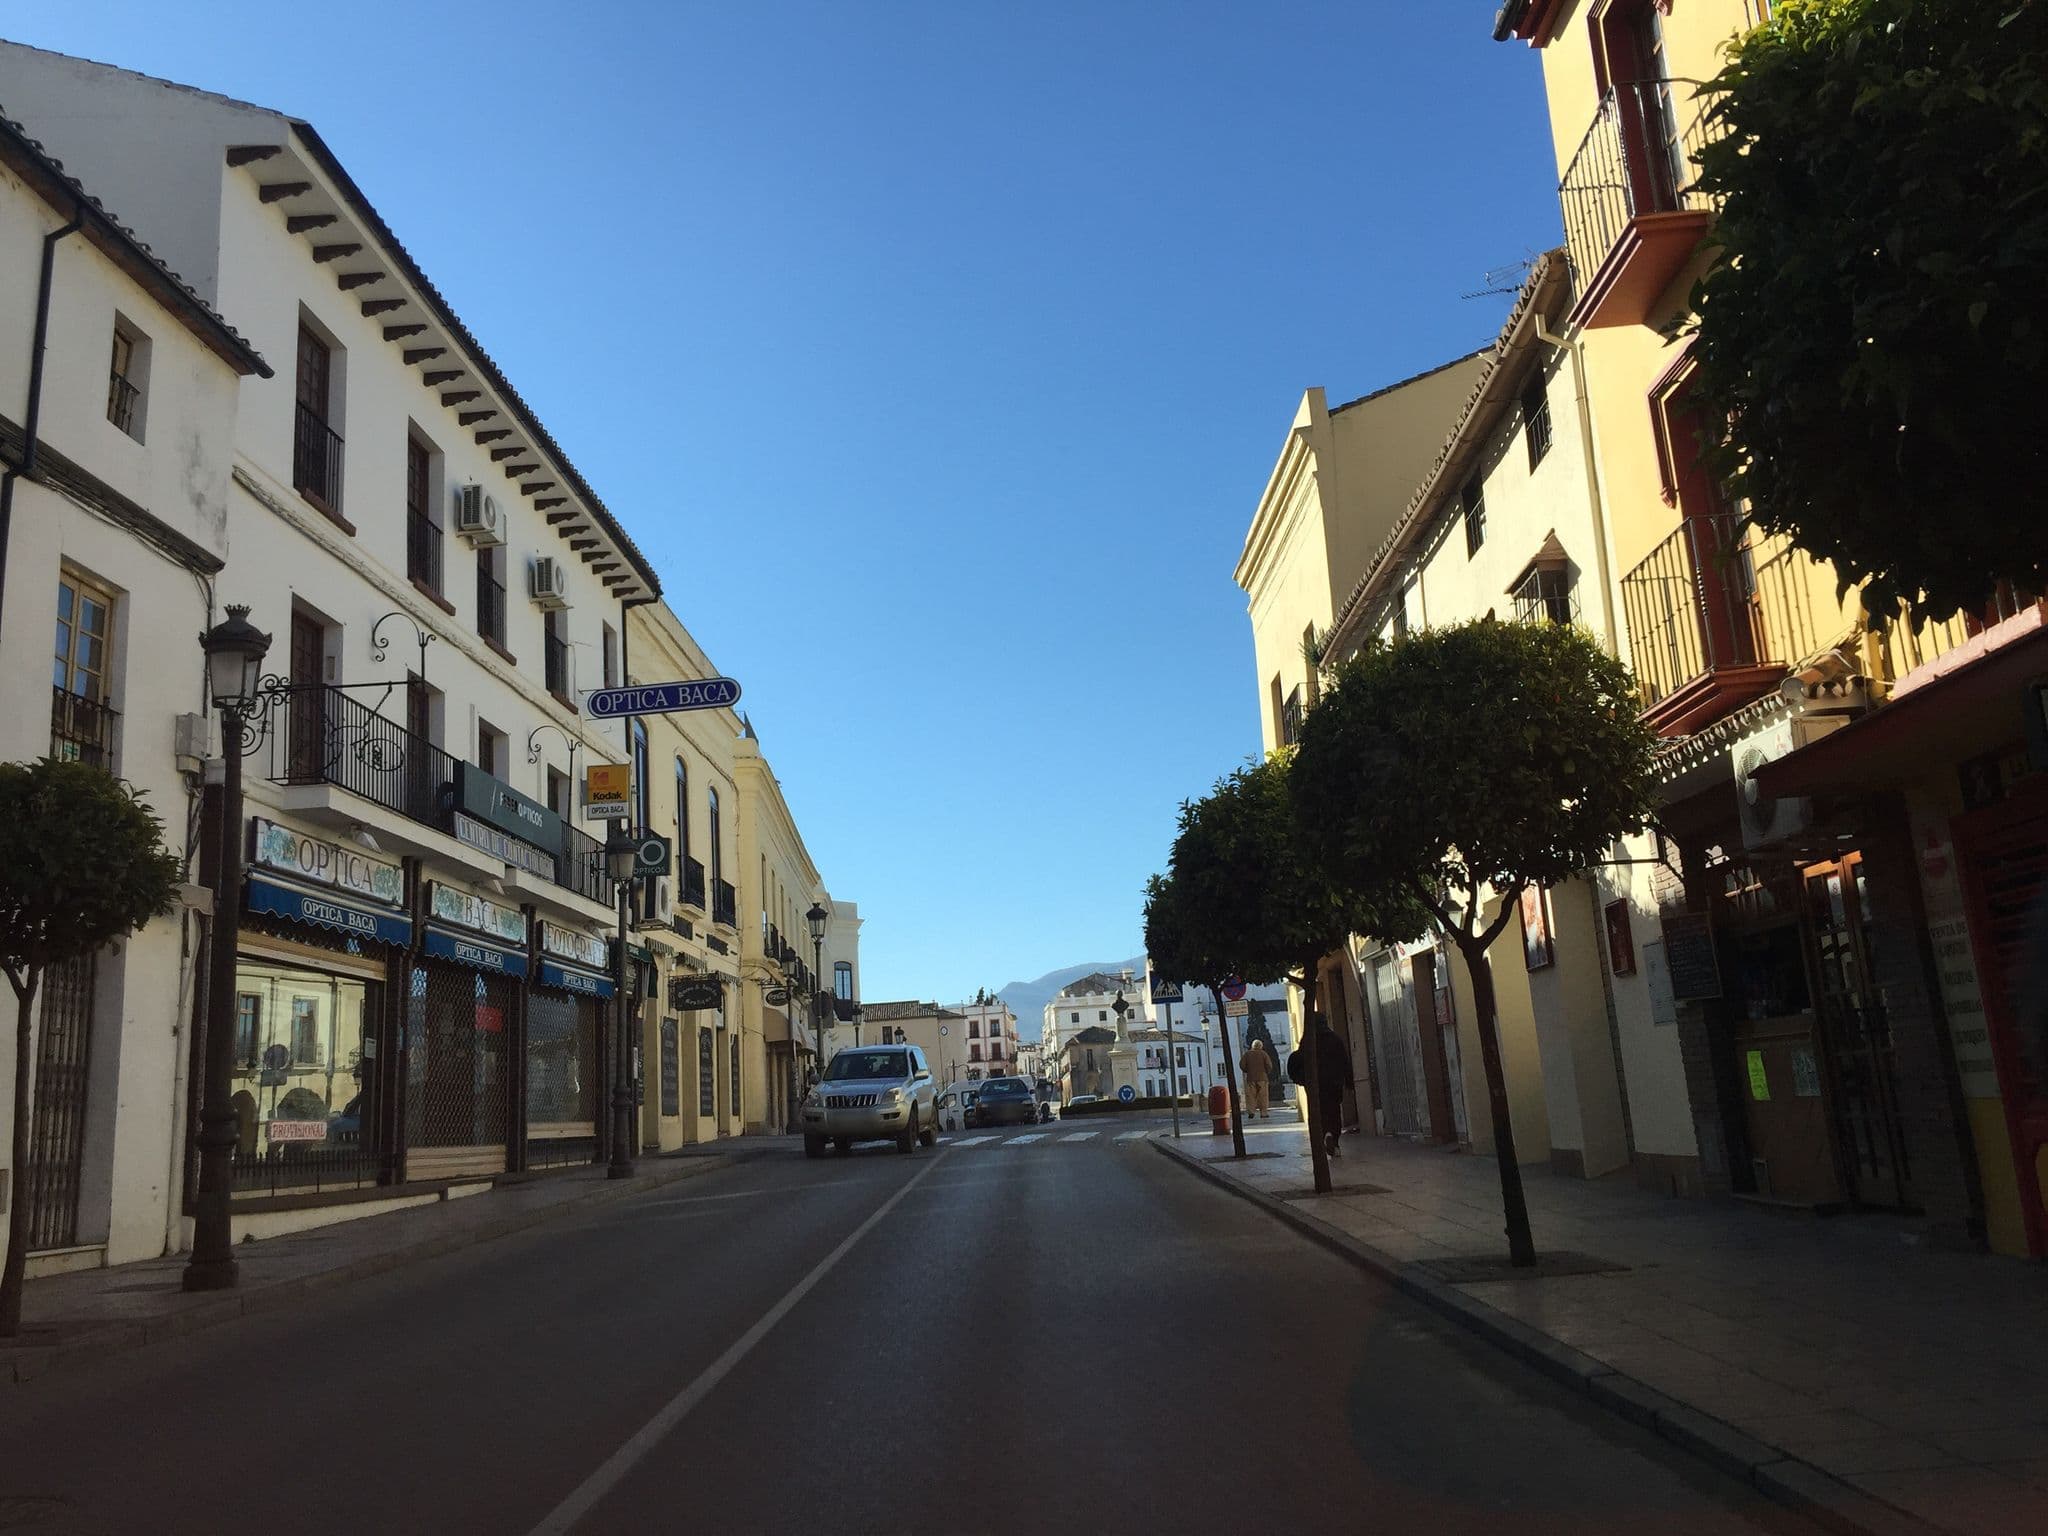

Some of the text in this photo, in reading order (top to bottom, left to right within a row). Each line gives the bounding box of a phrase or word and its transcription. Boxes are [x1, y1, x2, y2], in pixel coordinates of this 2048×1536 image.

[596, 683, 731, 712] OPTICA BACA
[593, 791, 622, 800] Kodak
[591, 805, 624, 814] OPTICA BACA
[300, 839, 373, 892] OPTICA
[304, 900, 375, 931] OPTICA BACA
[466, 896, 498, 932] BACA
[457, 944, 503, 966] OPTICA BACA
[563, 974, 582, 986] OPTICA
[272, 1123, 325, 1139] PROVISIONAL
